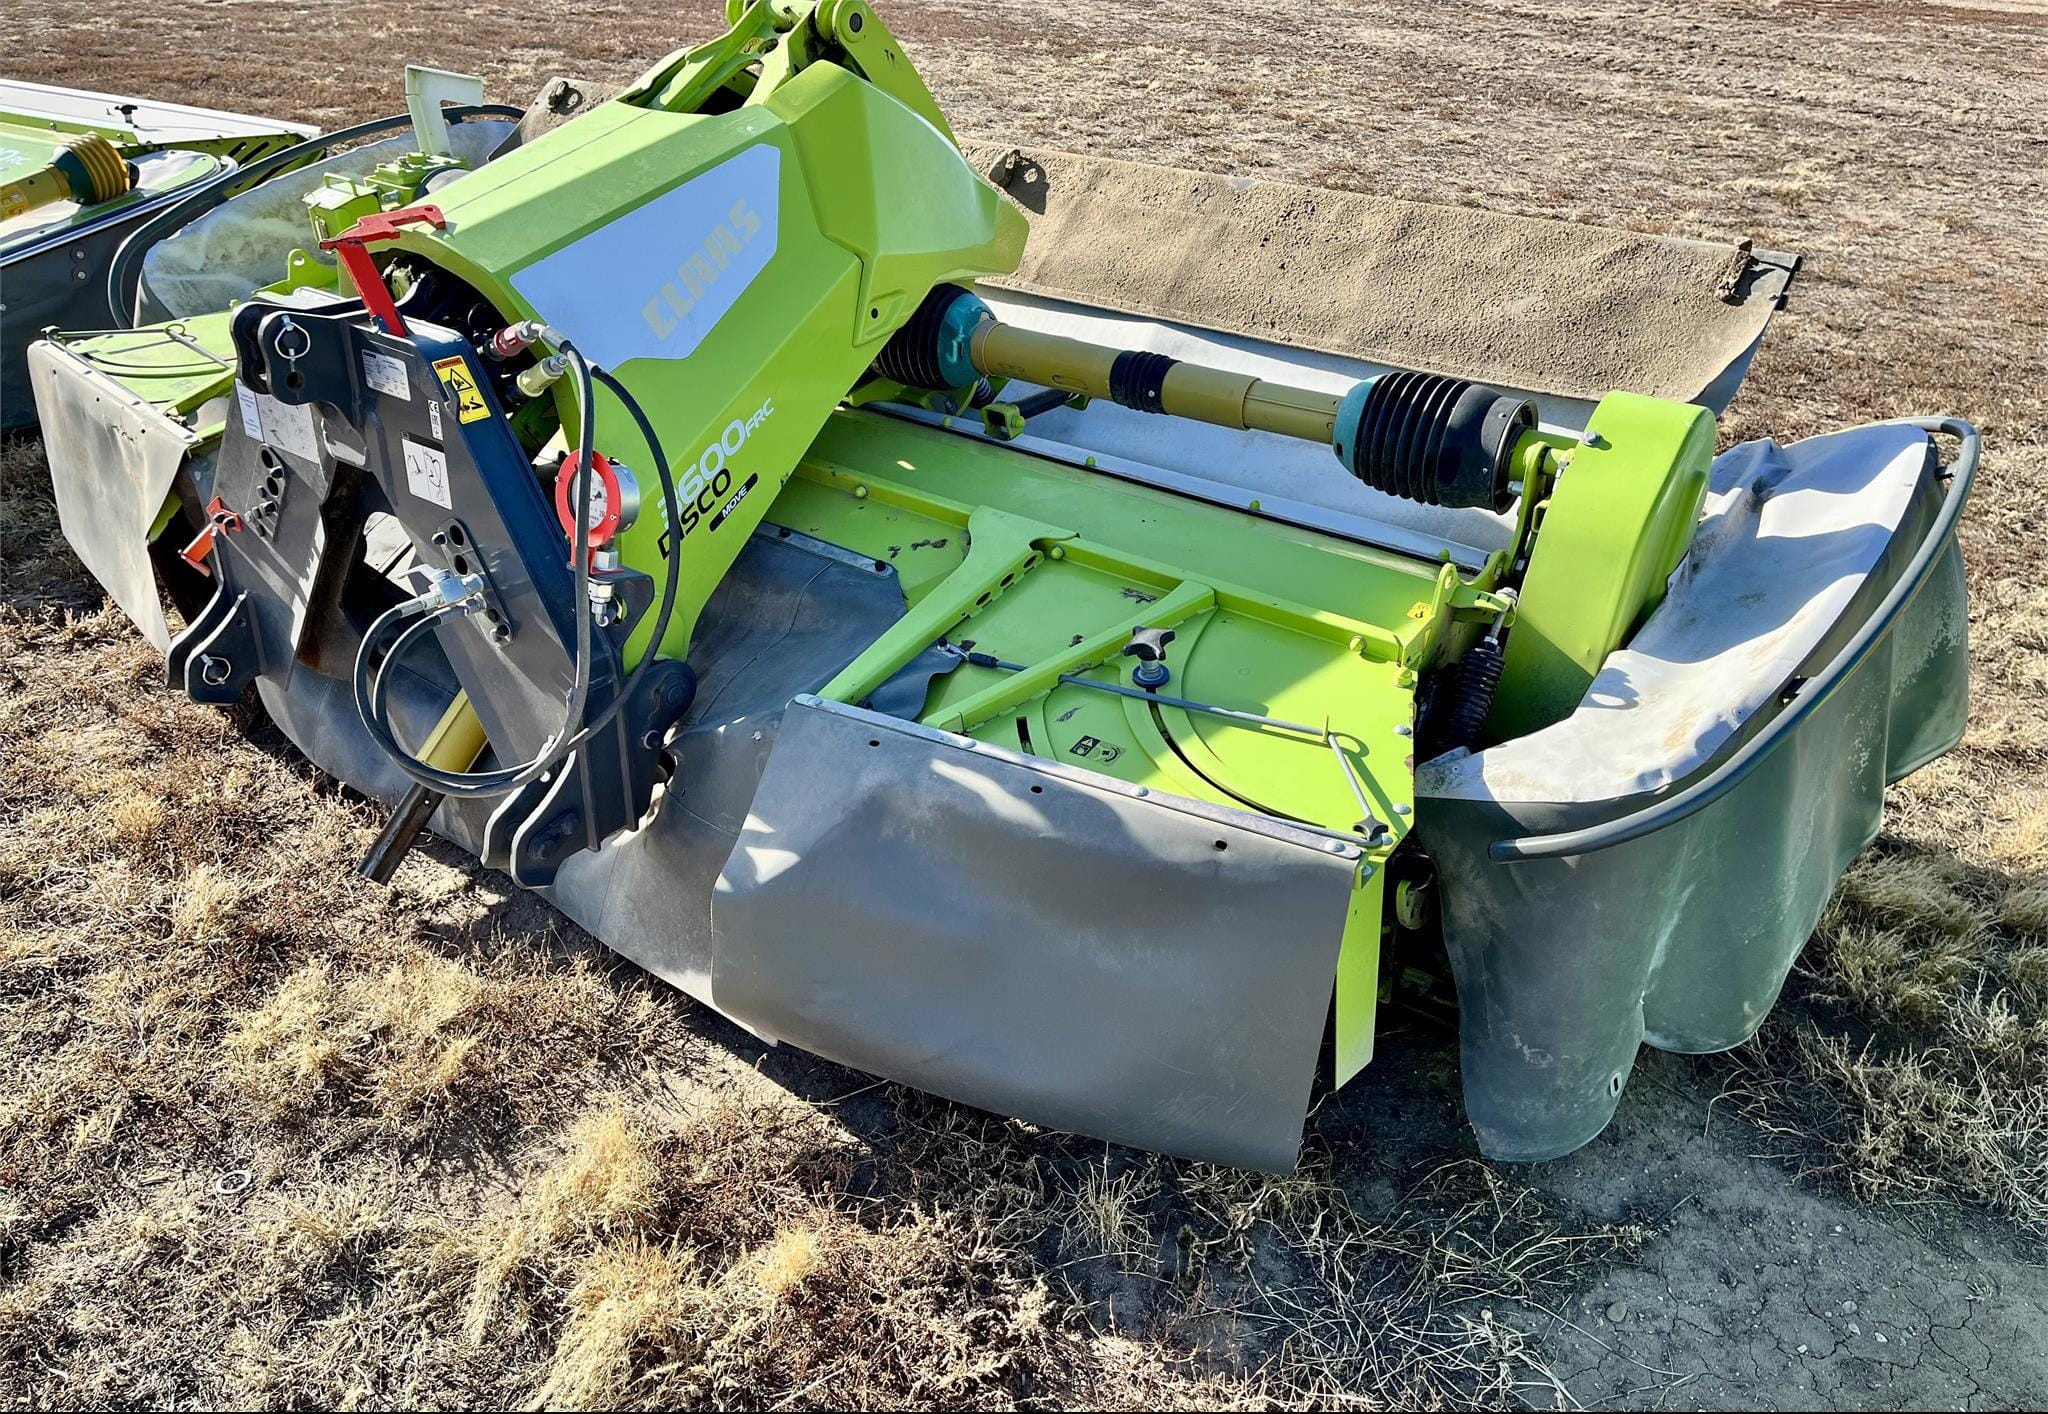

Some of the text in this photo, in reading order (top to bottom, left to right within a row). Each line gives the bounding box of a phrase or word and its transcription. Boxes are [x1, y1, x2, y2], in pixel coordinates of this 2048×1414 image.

[641, 198, 763, 342] CLAAS
[745, 397, 775, 438] FRC
[721, 484, 748, 518] MOVE
